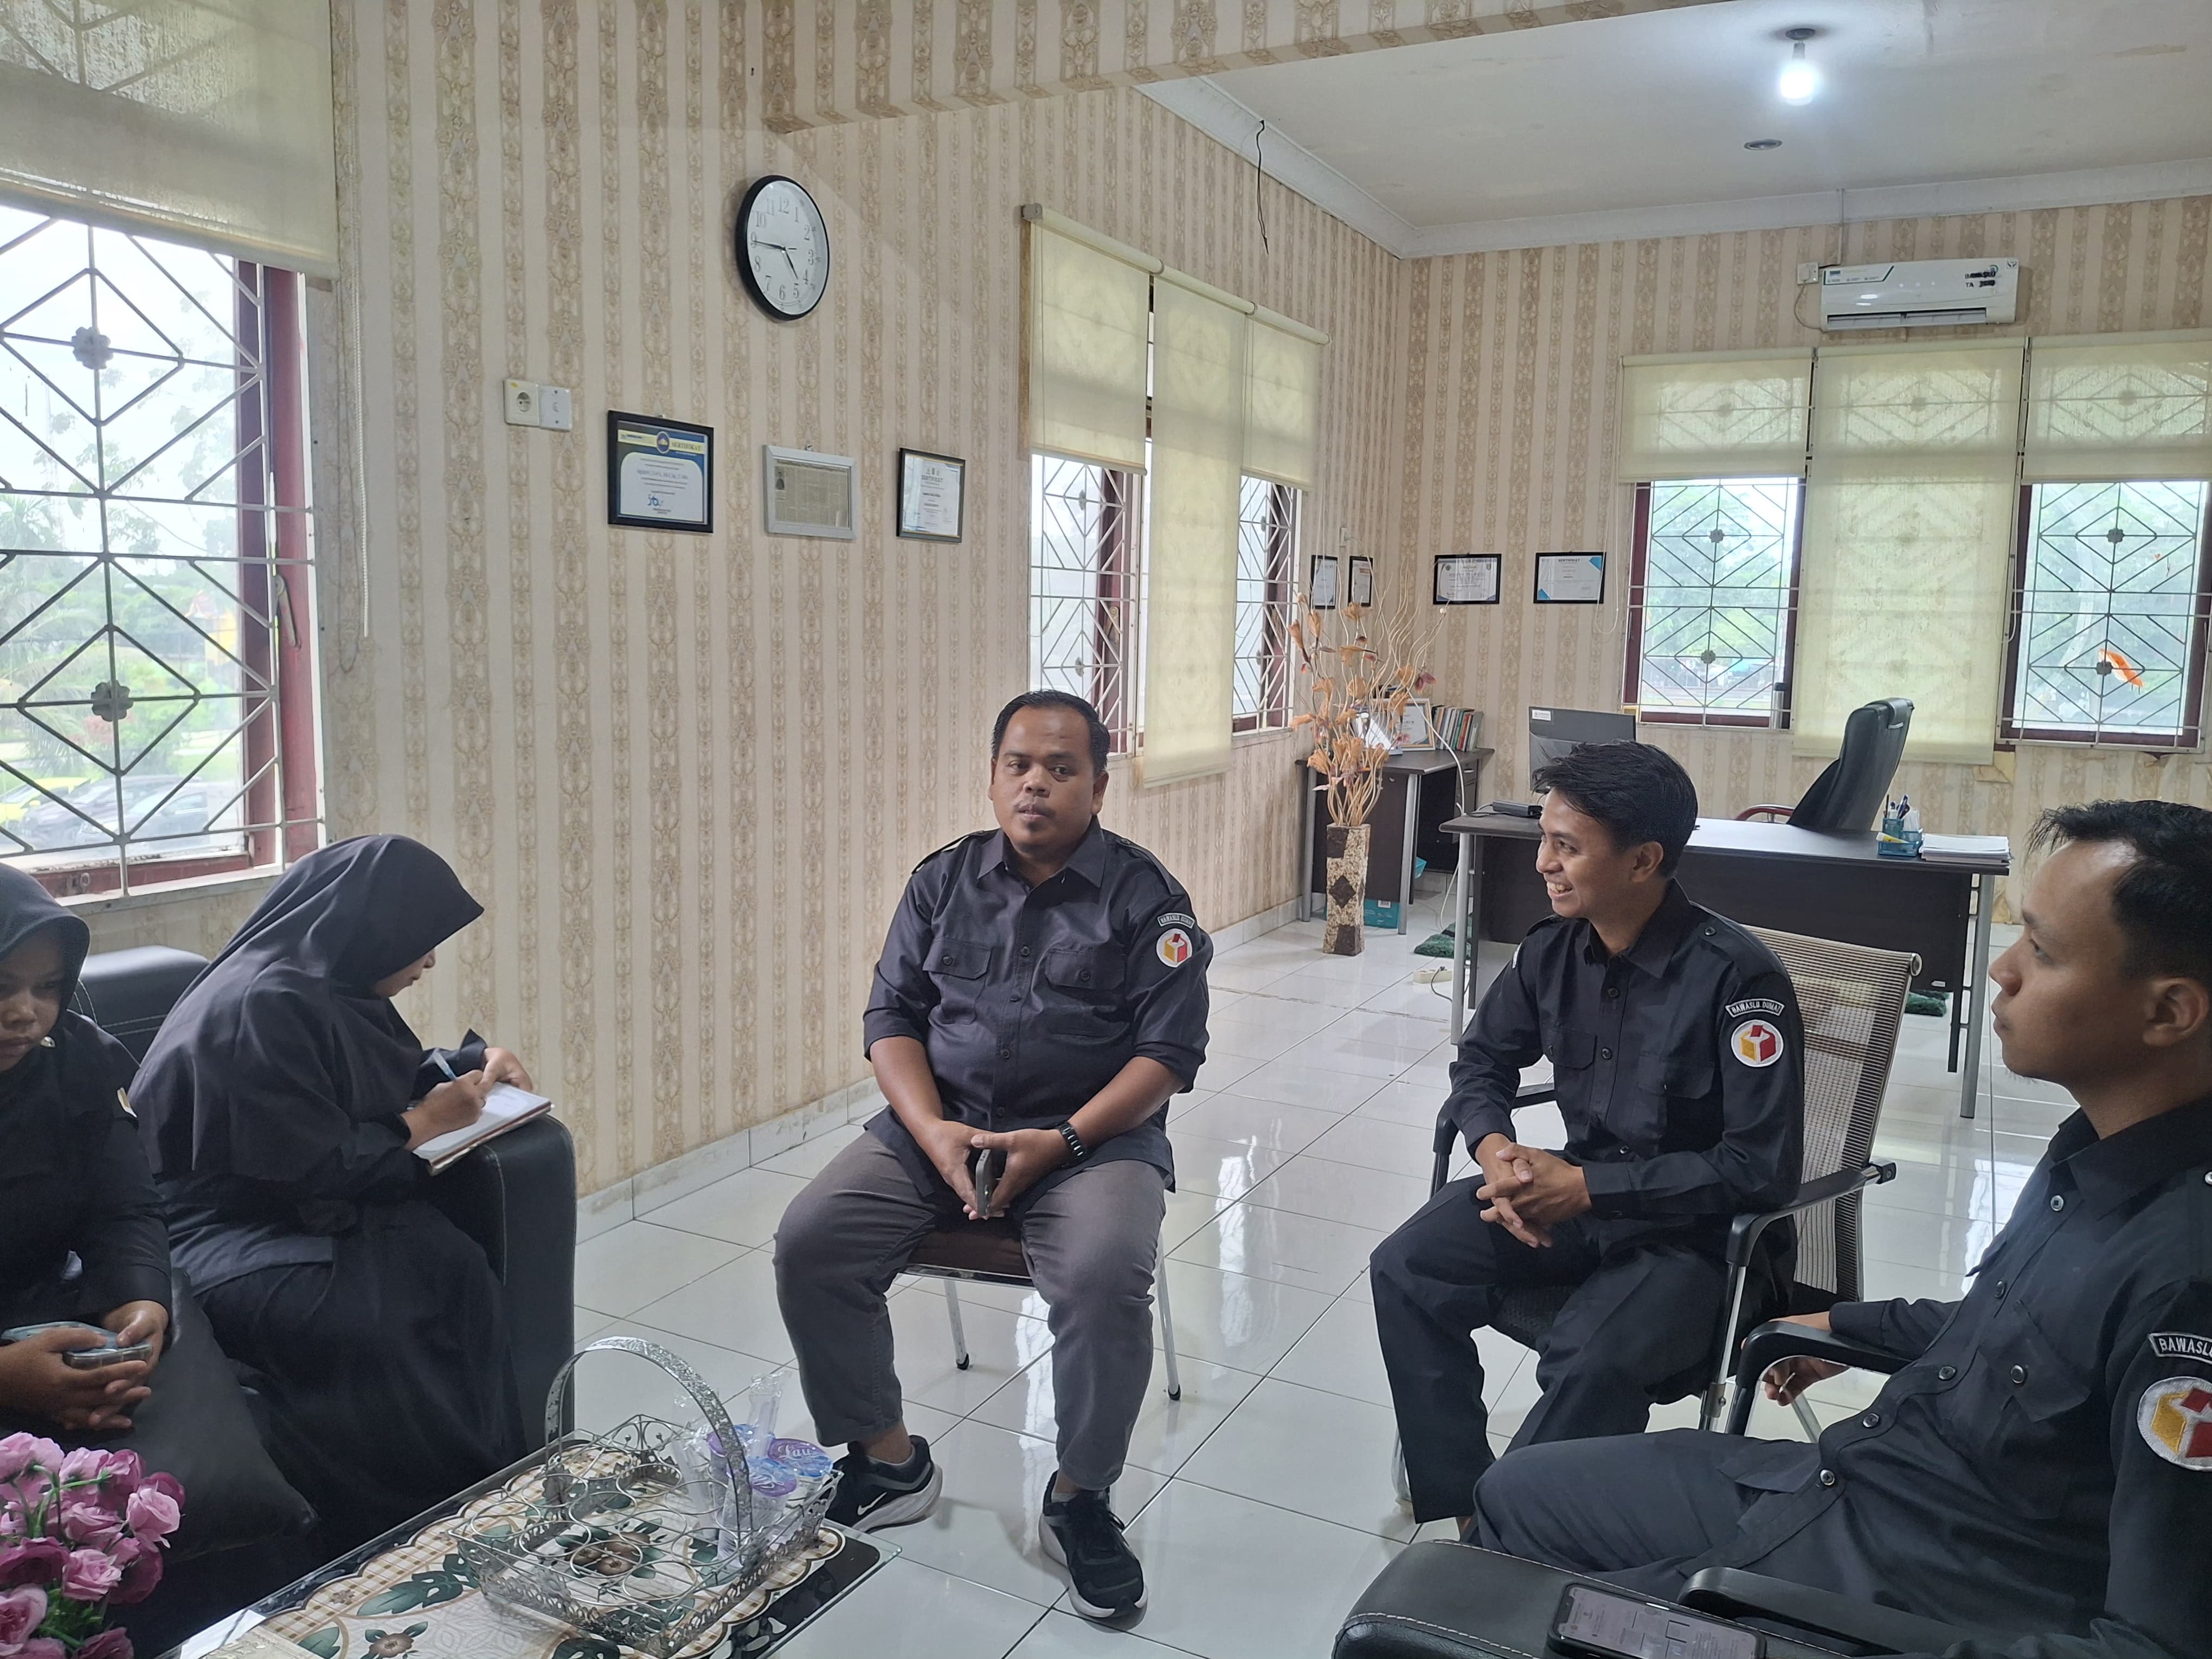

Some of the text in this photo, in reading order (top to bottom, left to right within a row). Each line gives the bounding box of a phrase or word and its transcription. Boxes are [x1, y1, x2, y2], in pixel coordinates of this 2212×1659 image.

[766, 199, 774, 216] 11
[779, 196, 789, 214] 12
[756, 211, 766, 228] 10
[794, 207, 799, 223] 1
[750, 232, 757, 248] 9
[804, 224, 810, 241] 2
[754, 255, 760, 272] 8
[808, 249, 814, 265] 3
[765, 275, 772, 291] 7
[803, 269, 808, 285] 4
[779, 285, 785, 300] 6
[793, 282, 799, 299] 5
[1732, 1001, 1781, 1014] BAWASLU DUMAI
